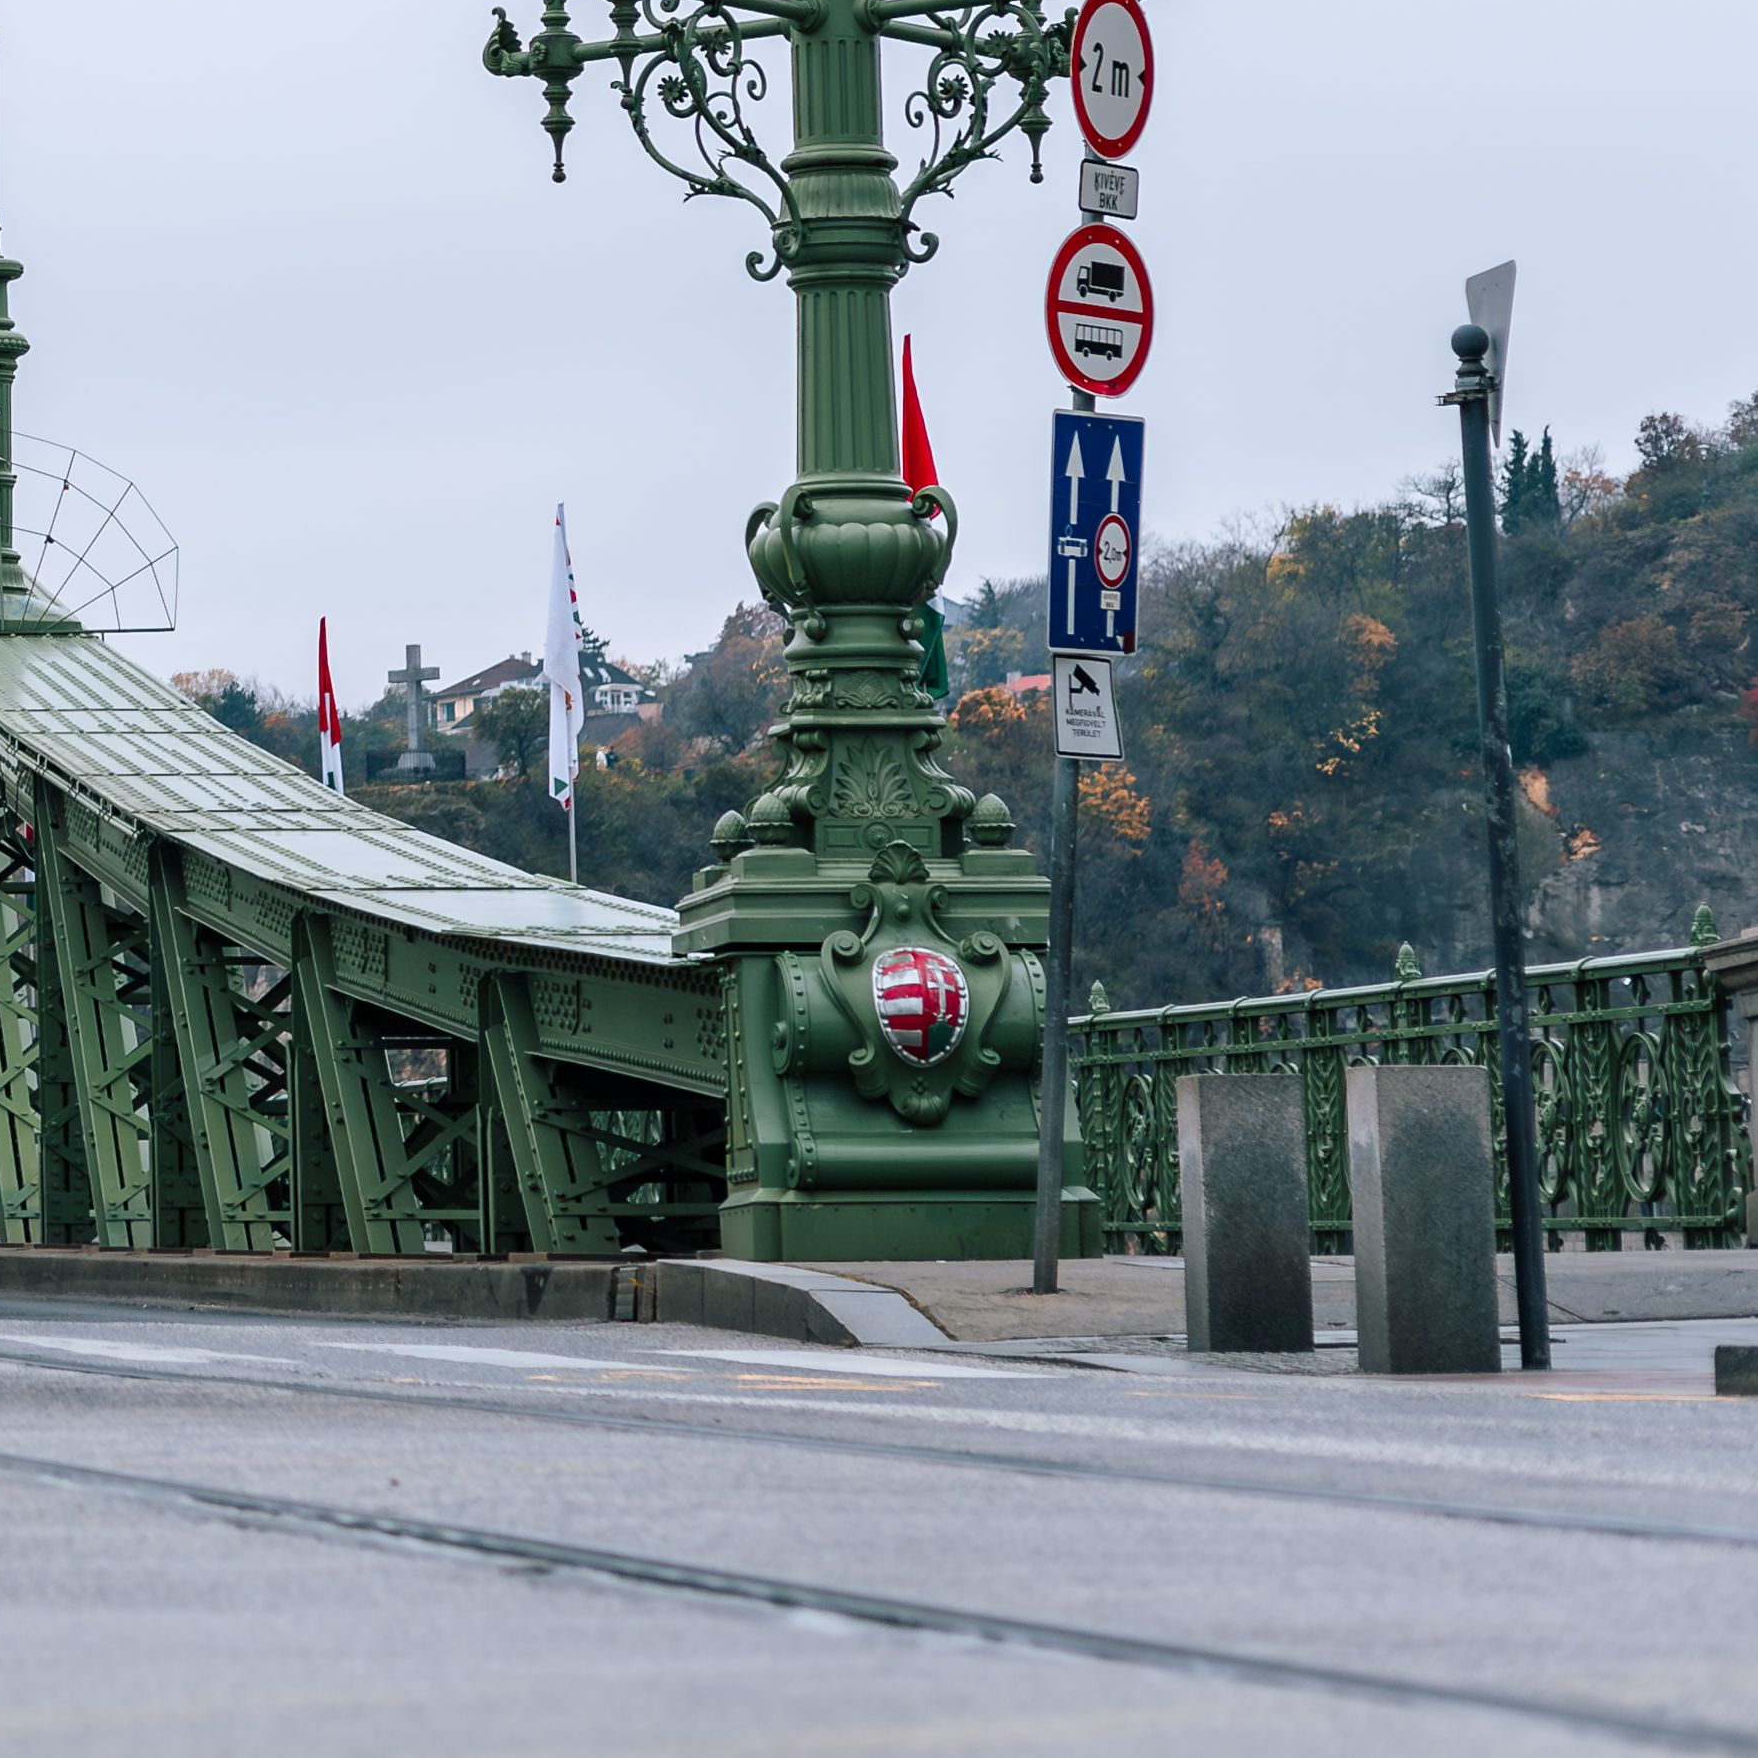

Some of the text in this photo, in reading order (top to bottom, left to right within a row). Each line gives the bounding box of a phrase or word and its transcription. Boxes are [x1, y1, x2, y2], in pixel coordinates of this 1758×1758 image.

[1091, 42, 1130, 98] 2 m
[1094, 170, 1126, 194] KIVÉVE
[1099, 192, 1118, 211] BKK
